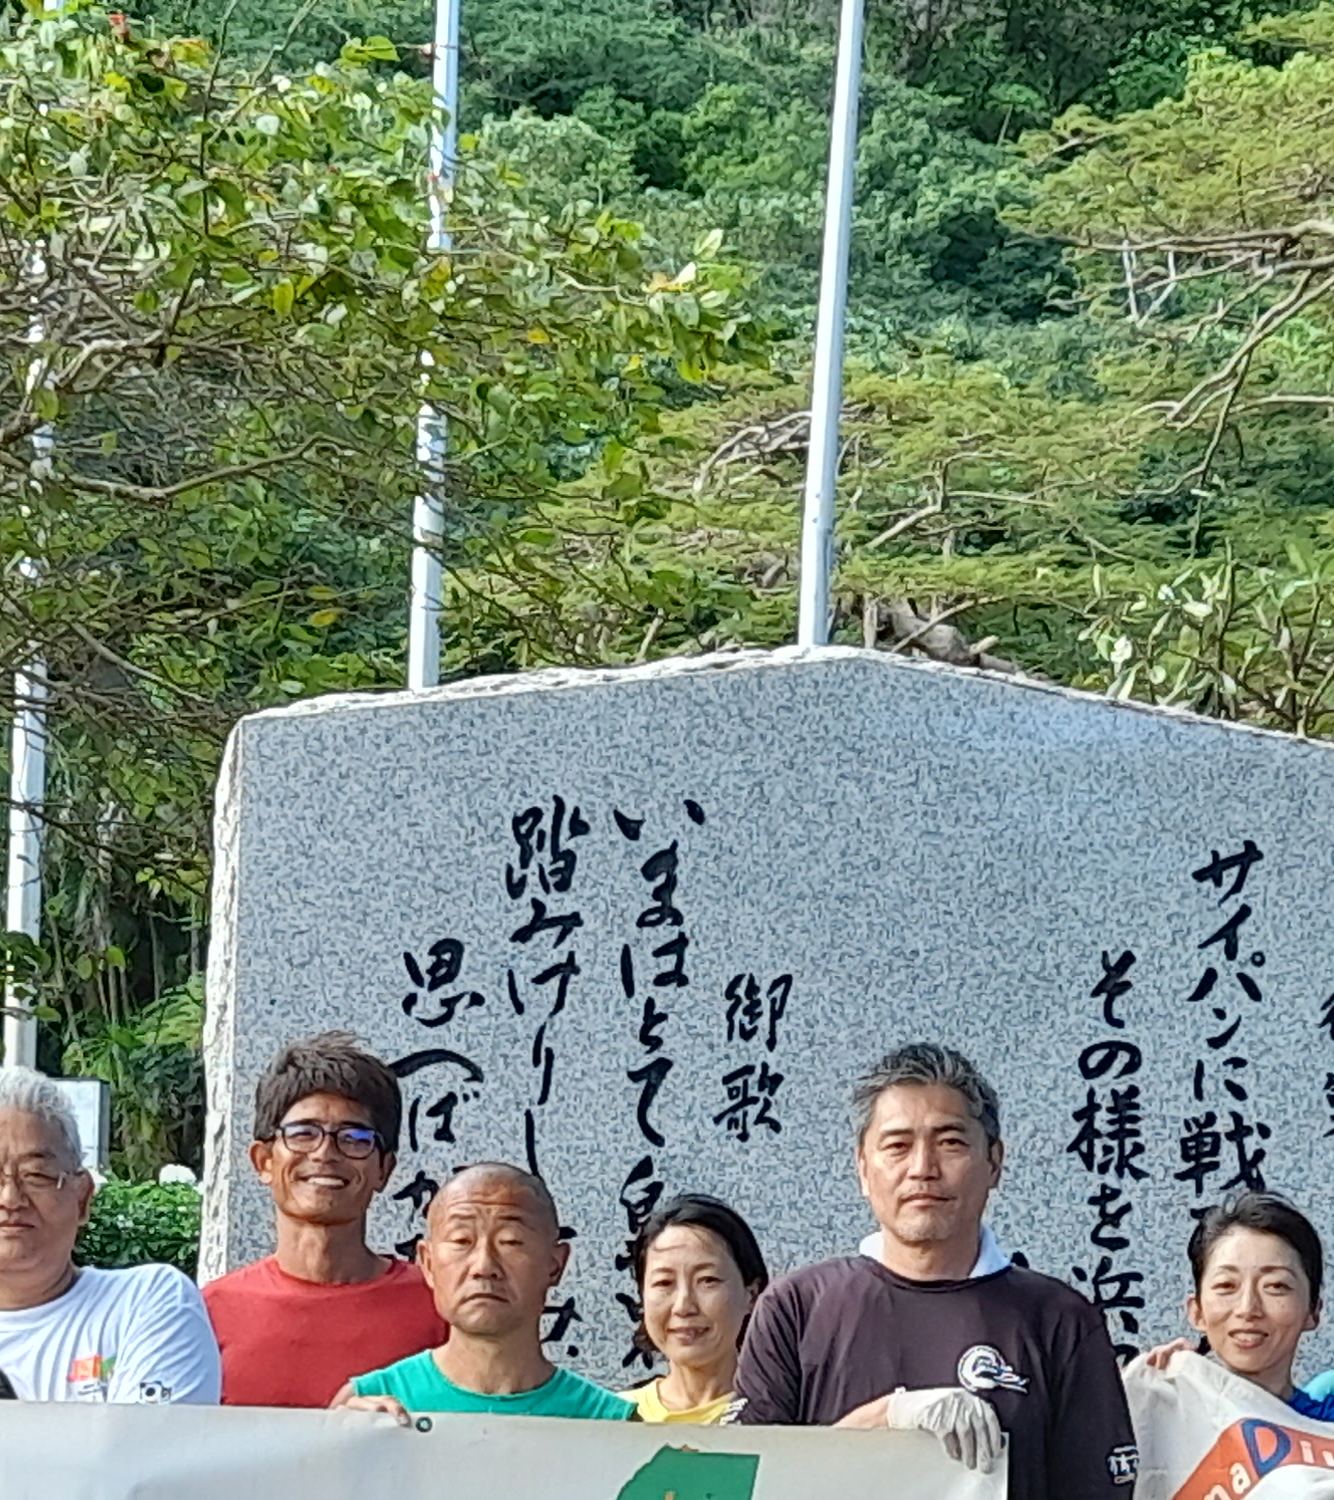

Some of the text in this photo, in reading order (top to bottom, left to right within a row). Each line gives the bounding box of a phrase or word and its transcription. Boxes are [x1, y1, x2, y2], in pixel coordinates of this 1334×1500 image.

[713, 972, 793, 1142] 御歌
[1172, 840, 1273, 1220] サイパンに戦
